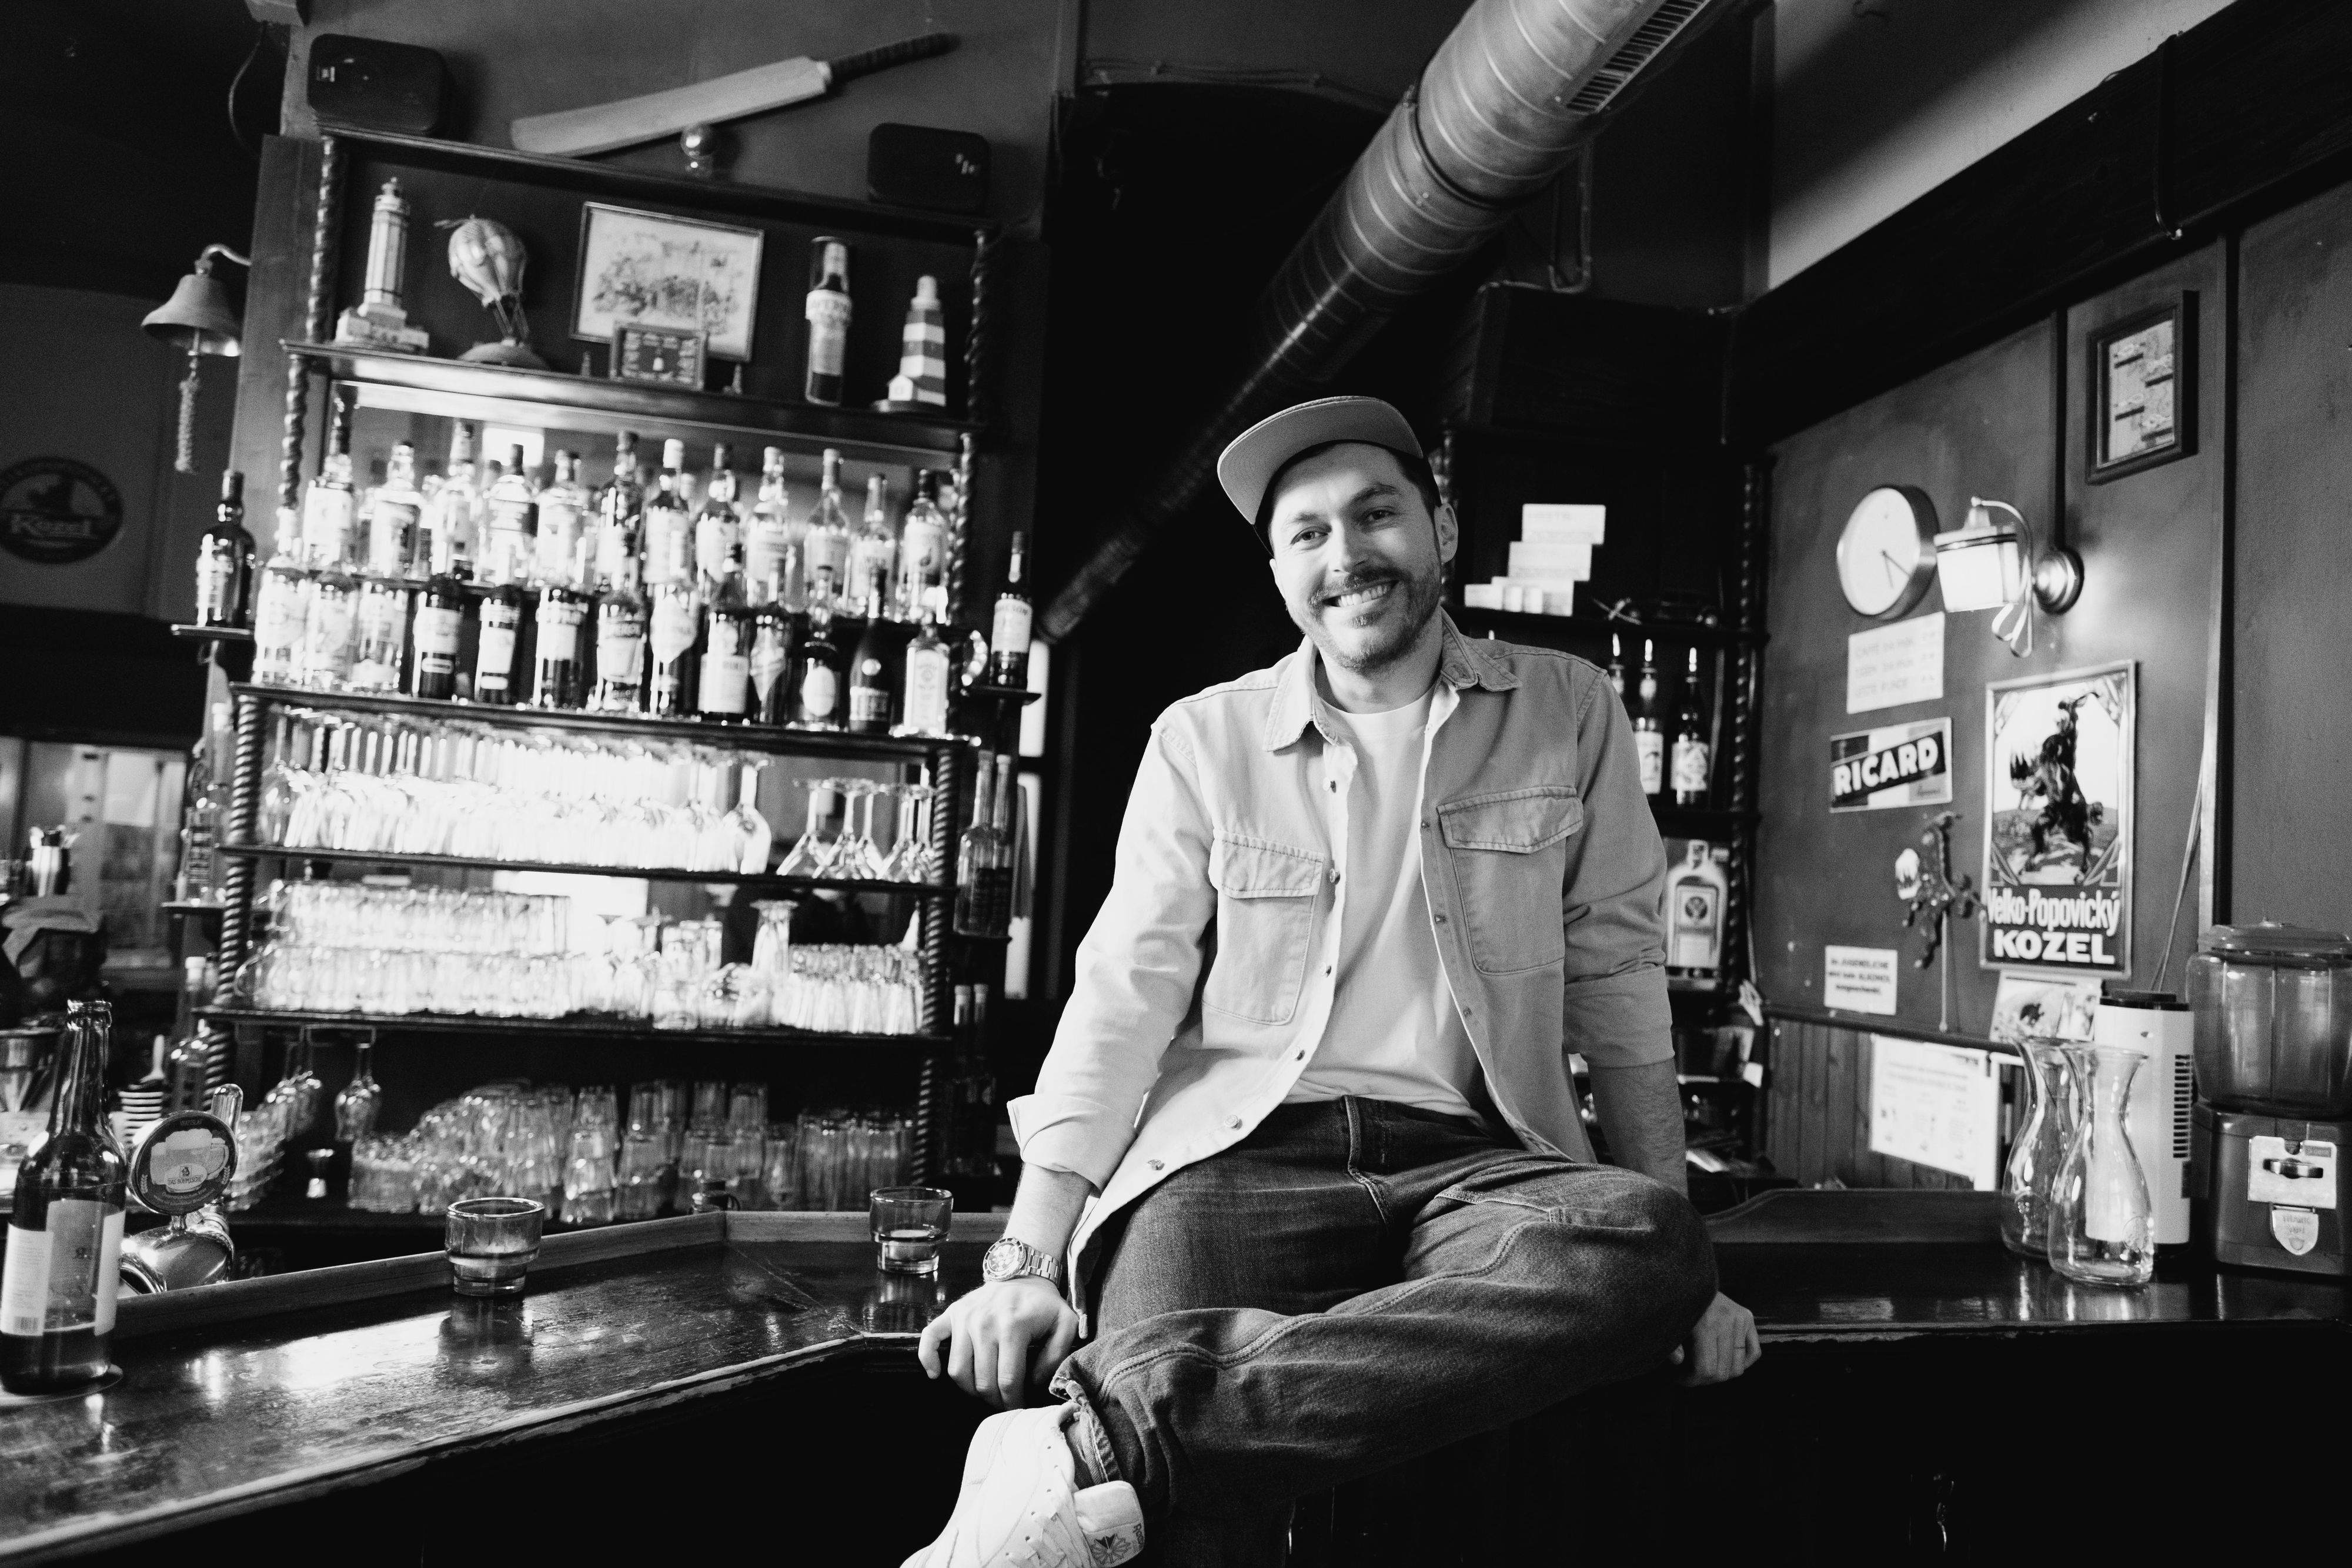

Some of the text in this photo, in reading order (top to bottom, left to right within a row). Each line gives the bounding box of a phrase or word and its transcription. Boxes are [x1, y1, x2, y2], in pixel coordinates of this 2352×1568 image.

[1834, 737, 1939, 795] RICARD
[1987, 888, 2120, 937] Velko-Popovický
[1994, 929, 2116, 964] KOZEL
